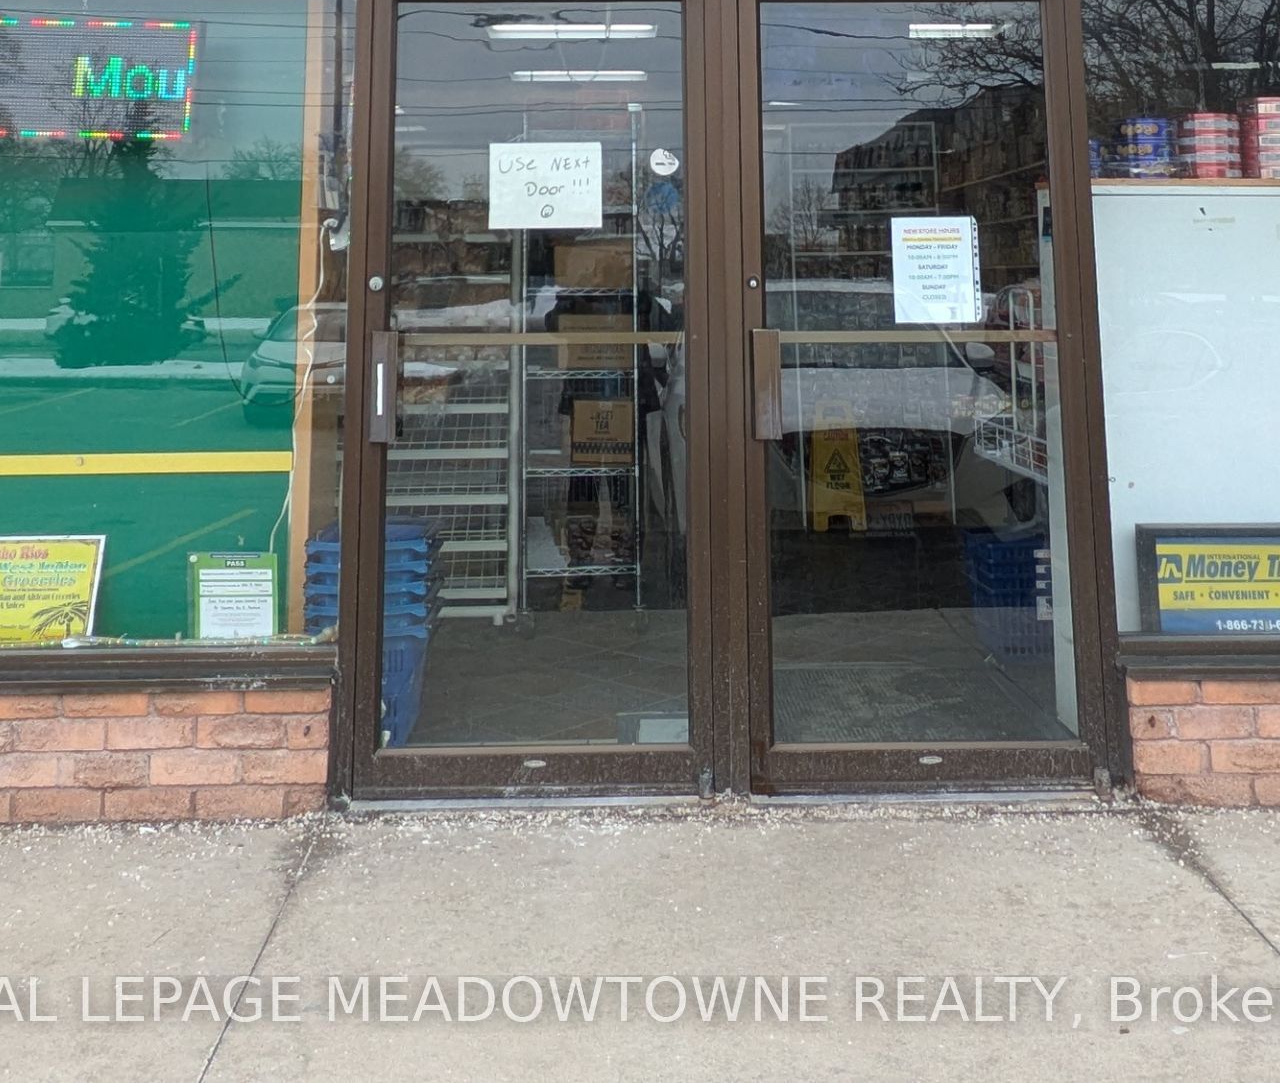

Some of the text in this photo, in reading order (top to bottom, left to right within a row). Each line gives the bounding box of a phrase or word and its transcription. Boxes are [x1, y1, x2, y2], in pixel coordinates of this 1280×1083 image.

[524, 181, 565, 197] Door
[1185, 554, 1261, 583] Money
[1173, 590, 1196, 601] SAFE
[1208, 589, 1271, 601] CONVENIENT
